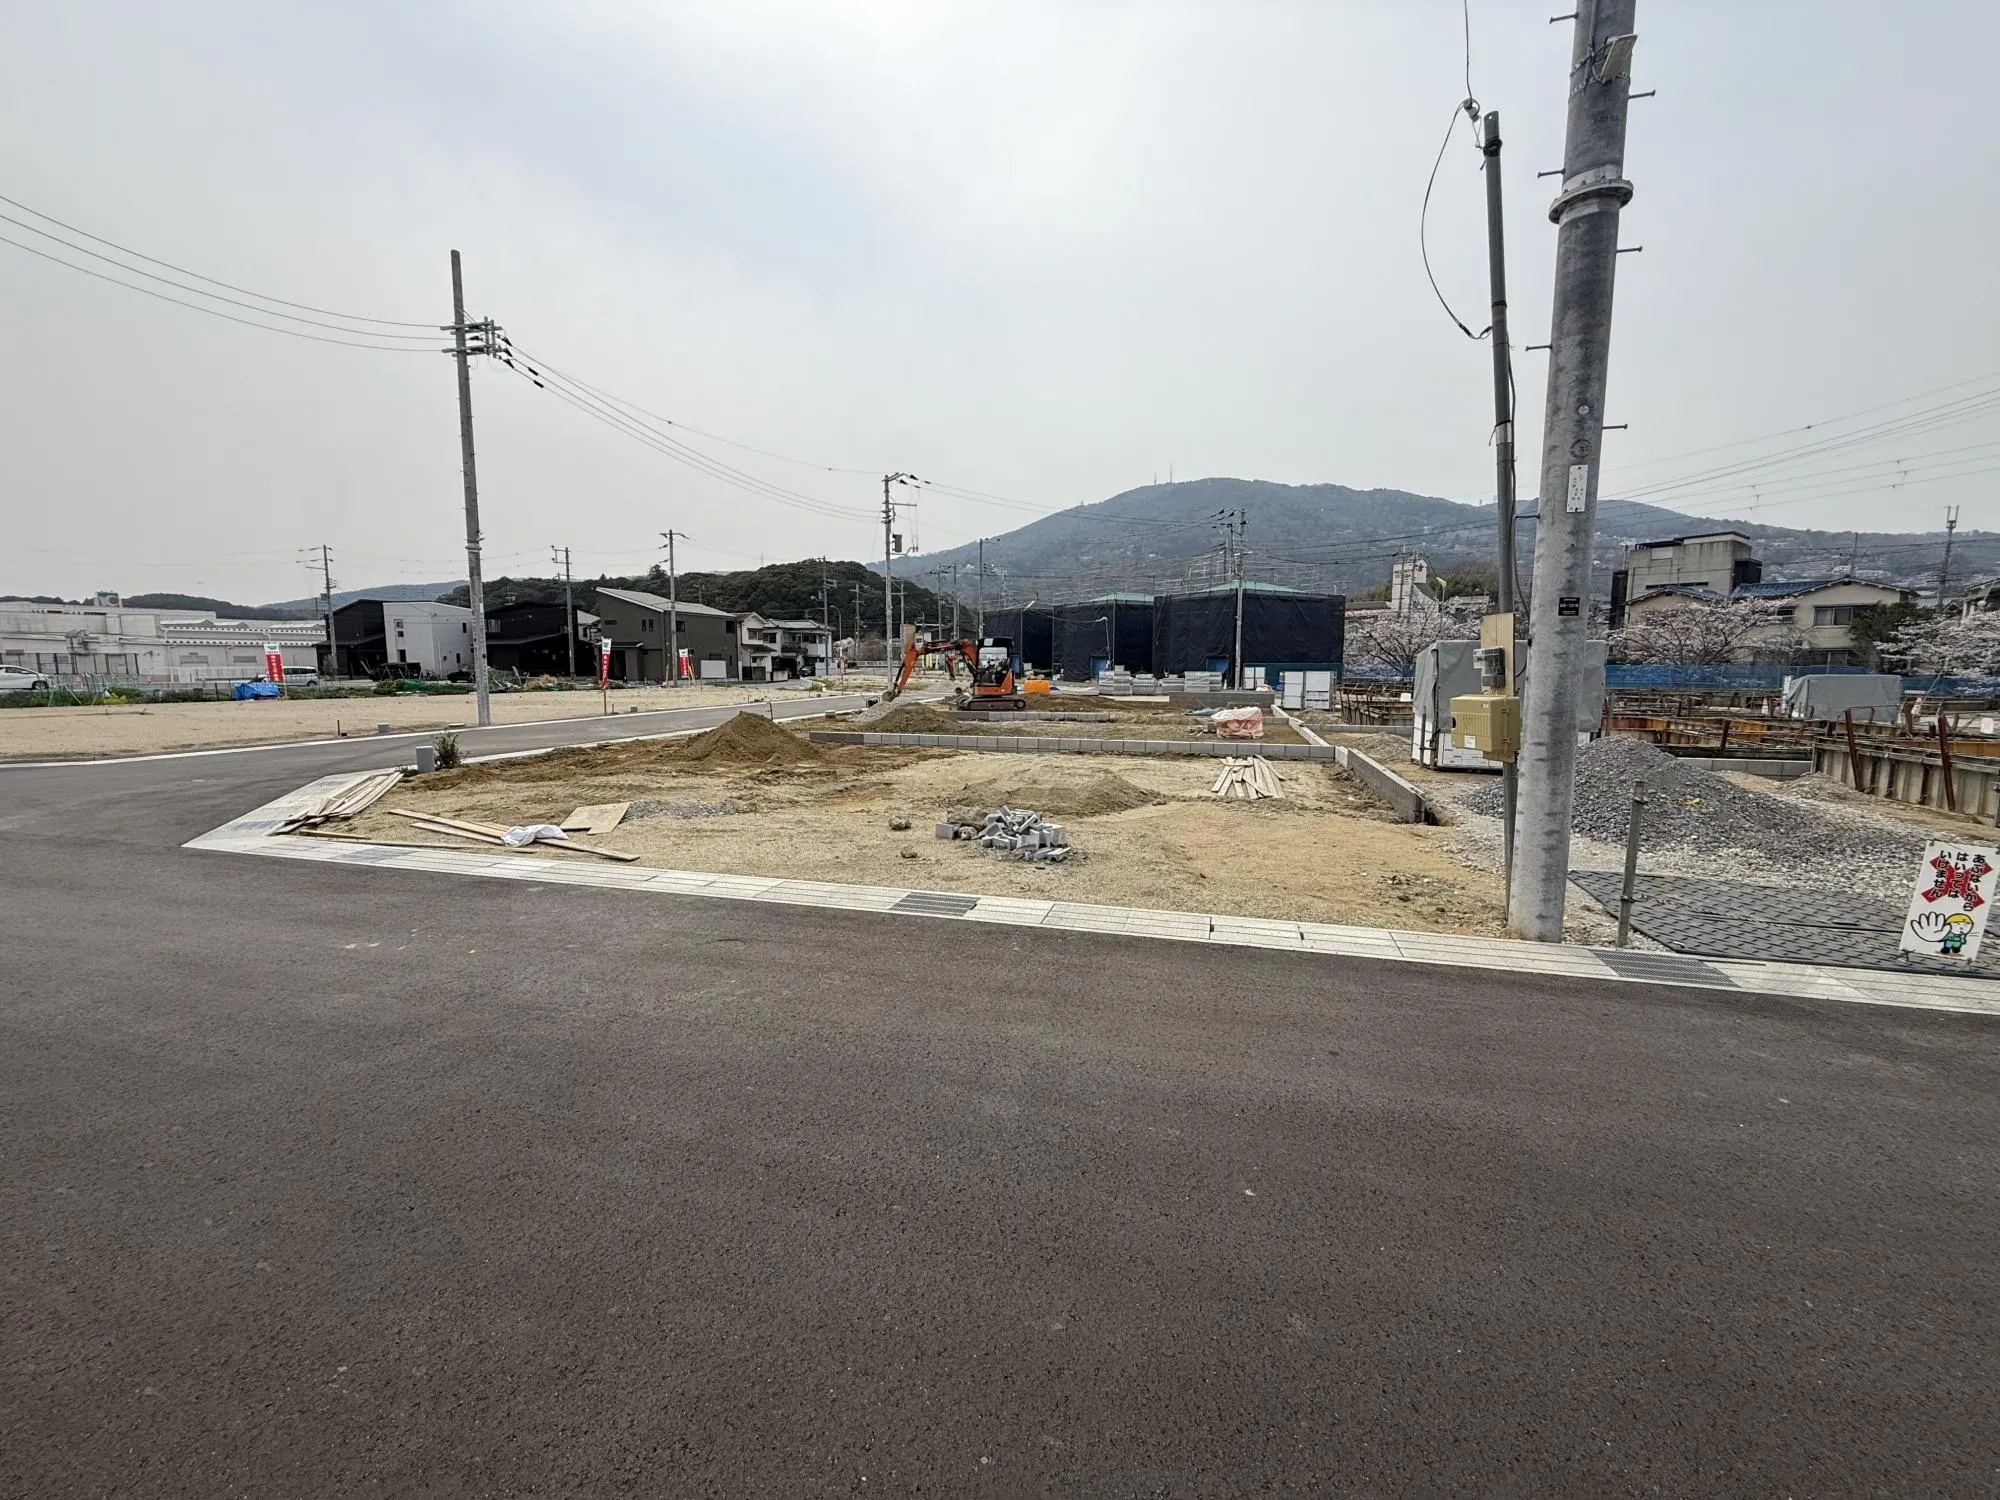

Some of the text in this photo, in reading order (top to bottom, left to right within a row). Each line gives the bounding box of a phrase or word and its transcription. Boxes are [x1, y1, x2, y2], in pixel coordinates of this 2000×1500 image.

[1931, 850, 1952, 898] いけません
[1948, 852, 1969, 899] はいっては
[1962, 854, 1986, 912] あぶないから
